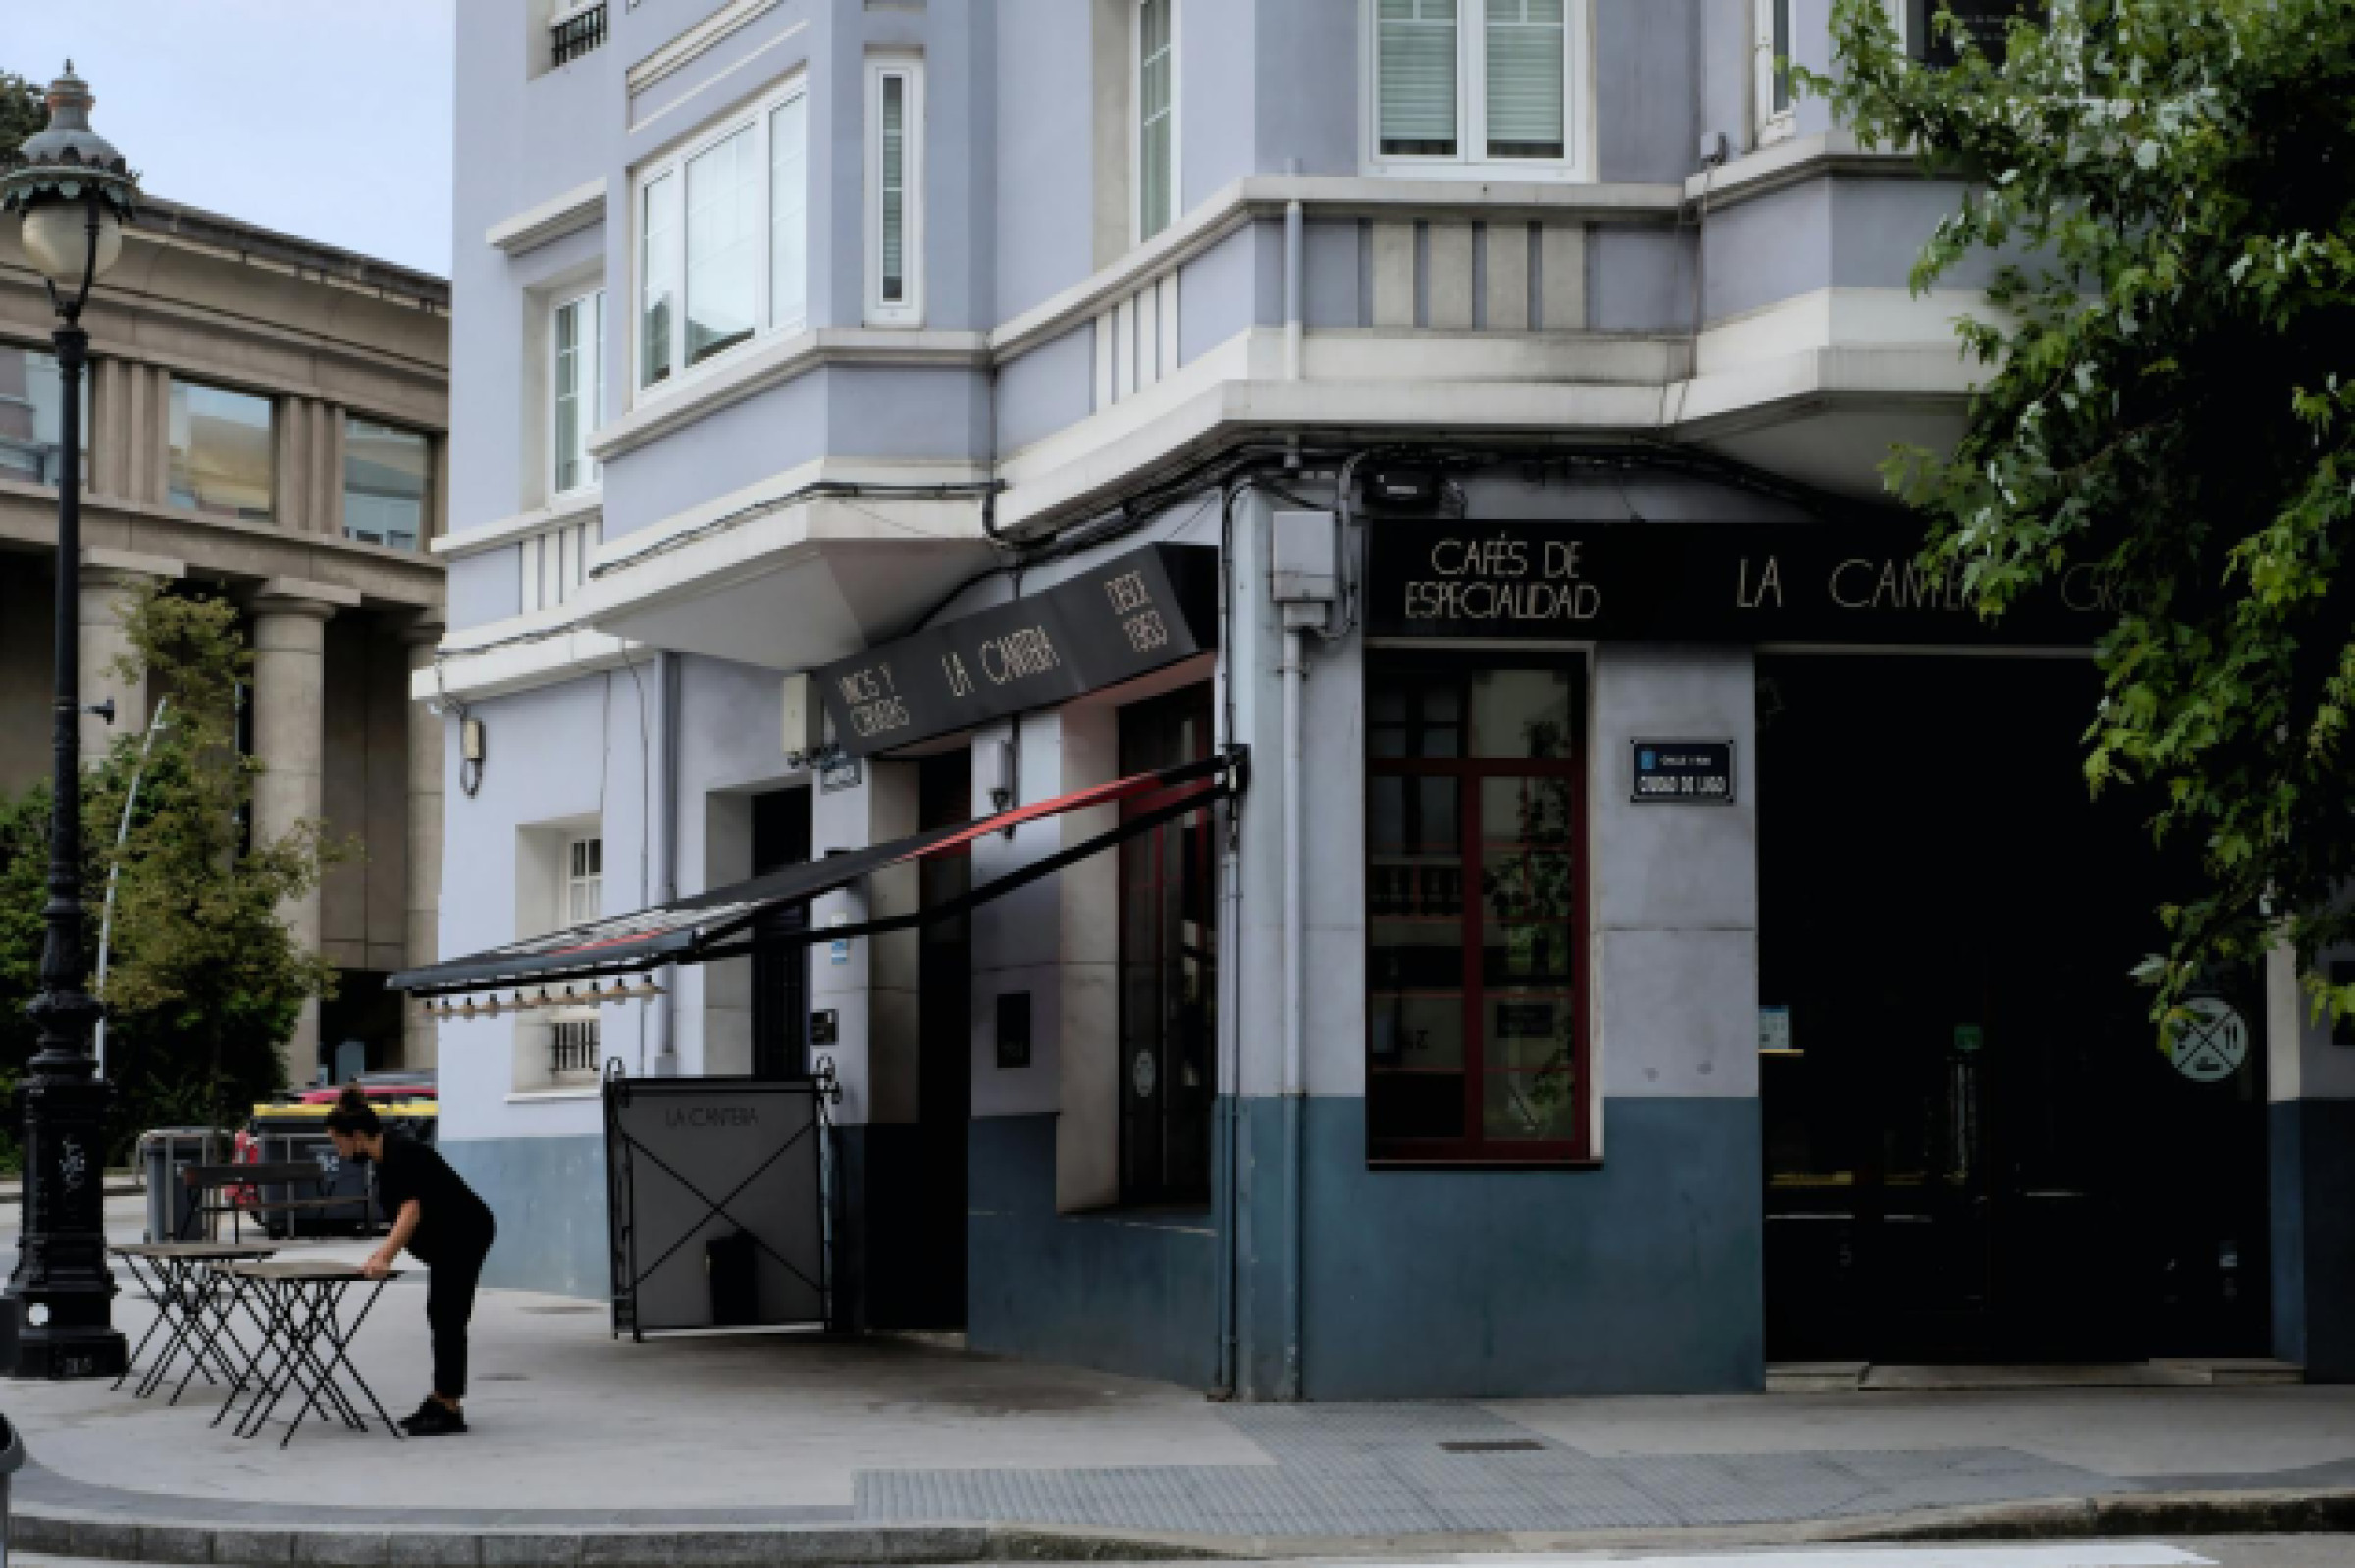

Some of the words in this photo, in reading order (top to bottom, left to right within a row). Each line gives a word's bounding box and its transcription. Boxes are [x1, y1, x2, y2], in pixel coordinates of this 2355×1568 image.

[1429, 530, 1530, 576] CAFÉS
[1544, 540, 1584, 579] DE
[1404, 580, 1603, 620] ESPECIALIDAD
[1736, 555, 1782, 608] LA
[942, 652, 974, 696] LA
[665, 1107, 685, 1127] LA
